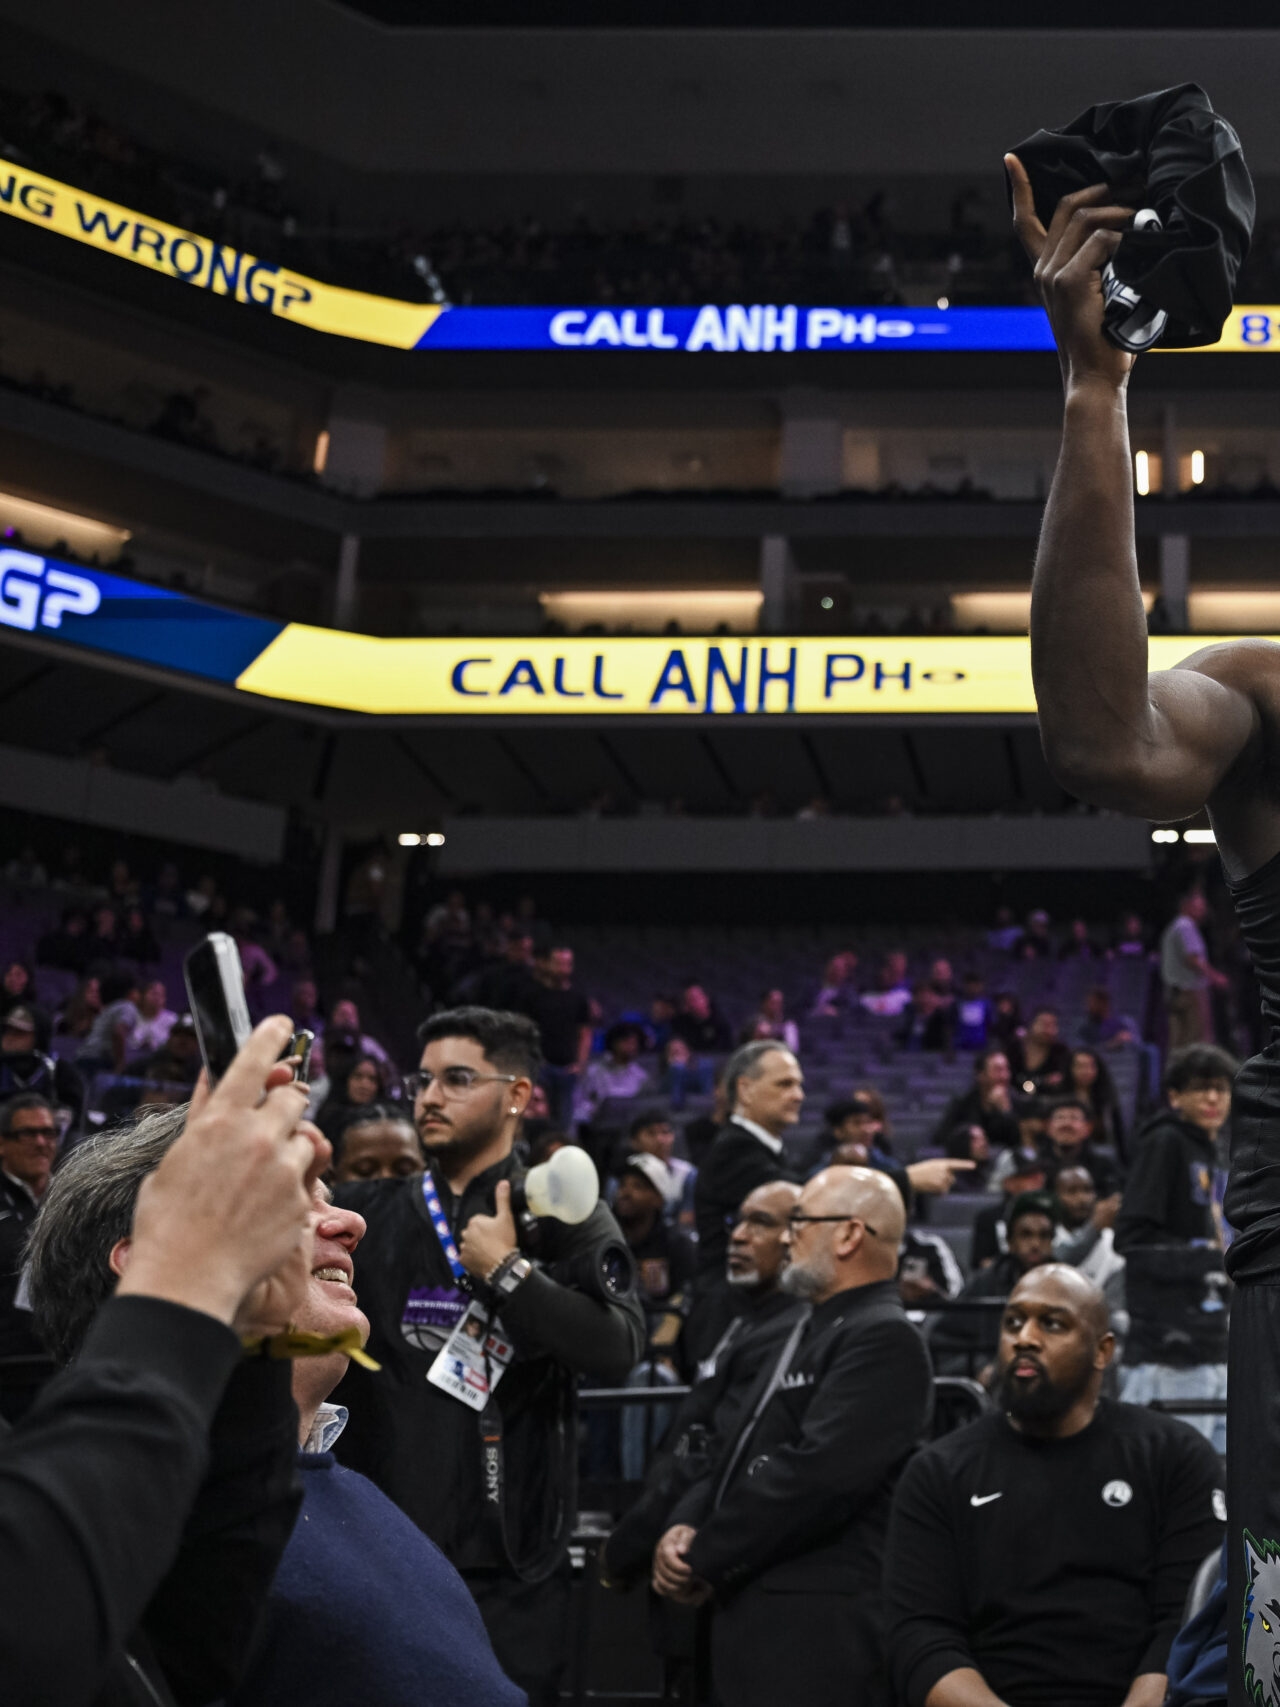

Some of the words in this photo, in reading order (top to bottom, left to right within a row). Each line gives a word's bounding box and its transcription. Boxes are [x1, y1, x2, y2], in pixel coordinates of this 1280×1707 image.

[74, 200, 313, 308] WRONG?
[548, 309, 679, 349] CALL
[686, 305, 798, 351] ANH
[449, 655, 626, 700] CALL
[649, 646, 798, 713] ANH
[485, 1446, 500, 1505] SONY
